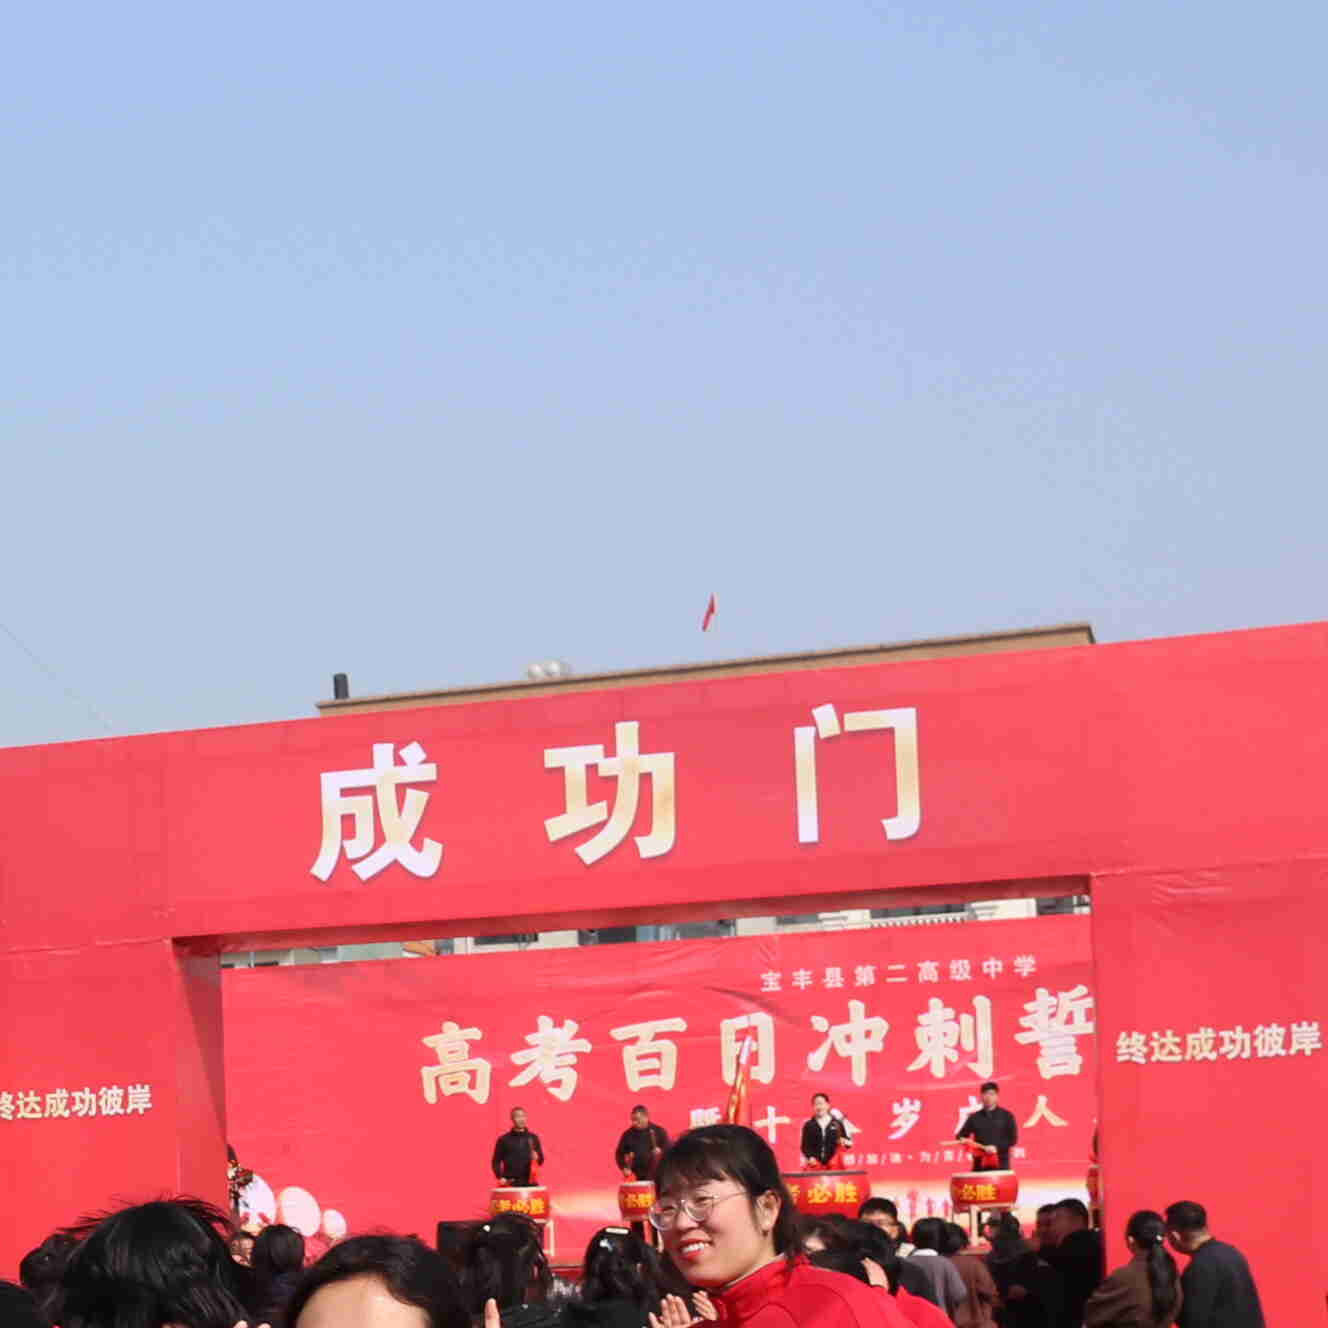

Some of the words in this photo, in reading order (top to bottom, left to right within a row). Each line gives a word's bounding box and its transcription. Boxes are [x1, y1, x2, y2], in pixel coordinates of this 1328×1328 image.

[309, 702, 922, 882] 成功门
[760, 955, 1037, 992] 宝丰县第二高级中学
[420, 984, 1096, 1105] 高考百日冲刺誓
[1116, 1020, 1323, 1064] 终达成功彼岸
